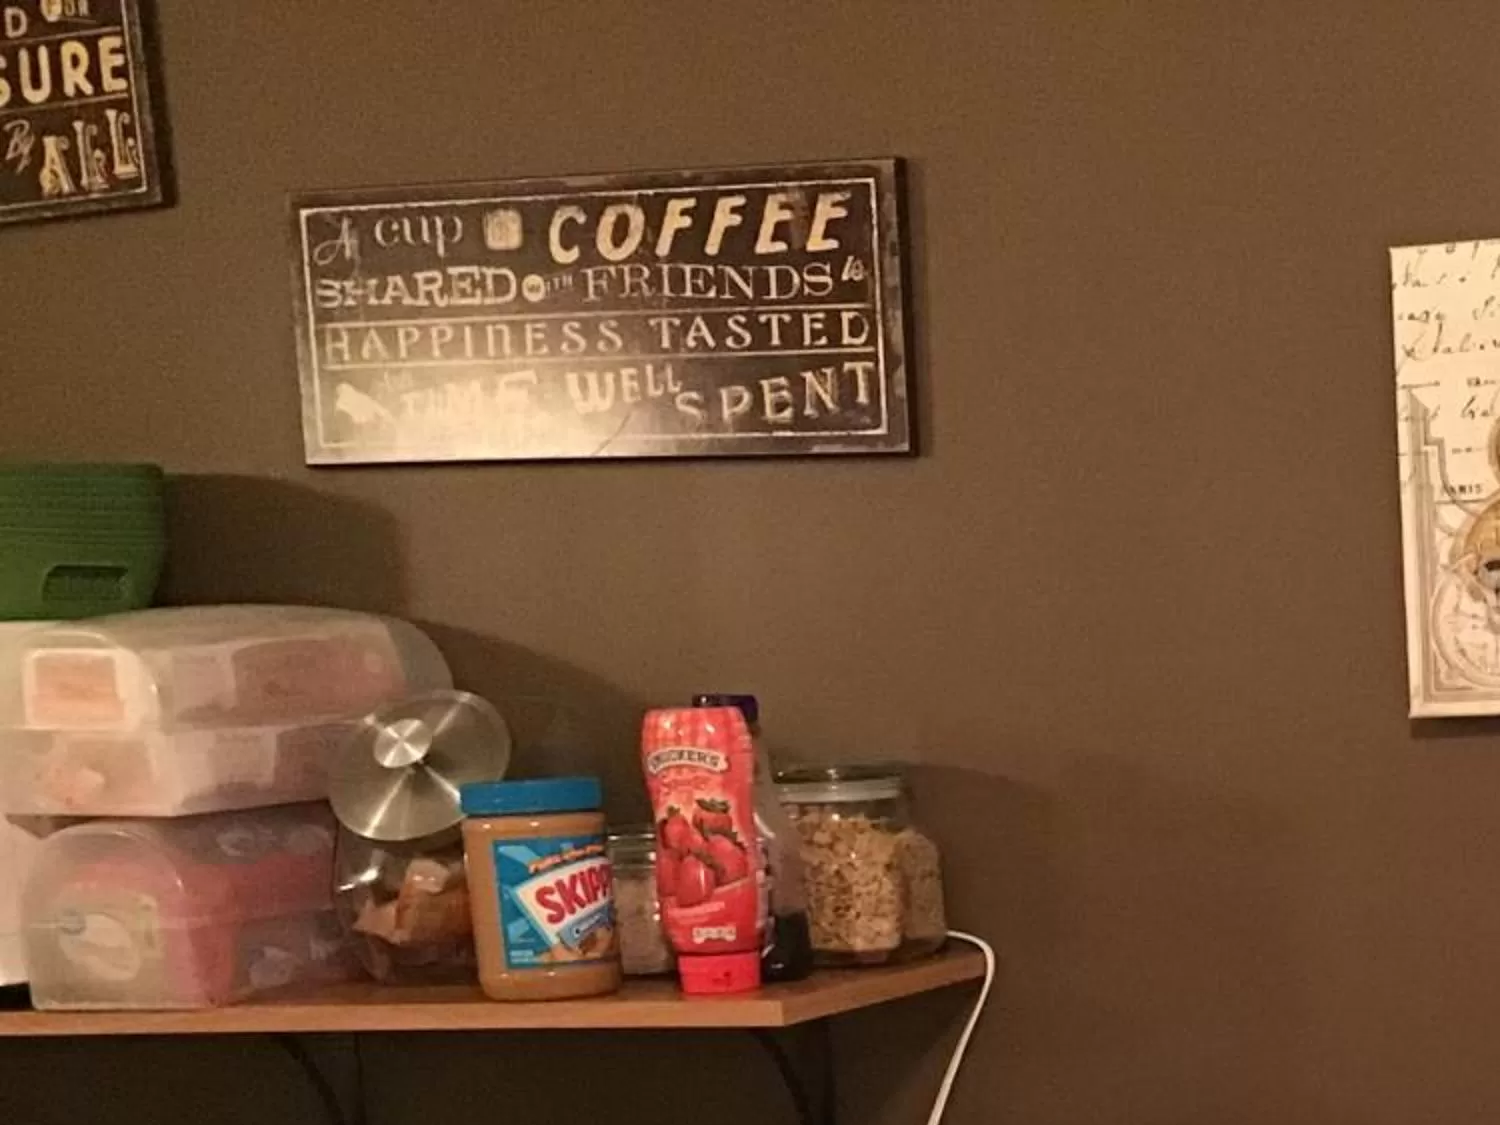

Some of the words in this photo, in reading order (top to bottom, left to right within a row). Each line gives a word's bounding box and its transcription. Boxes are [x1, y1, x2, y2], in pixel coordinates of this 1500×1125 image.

[373, 213, 464, 258] cup
[549, 191, 851, 265] COFFEE
[315, 265, 518, 309] SHARED
[579, 260, 834, 300] FRIENDS
[648, 310, 870, 350] TASTED
[565, 363, 683, 414] WELL
[674, 361, 875, 425] SPENT
